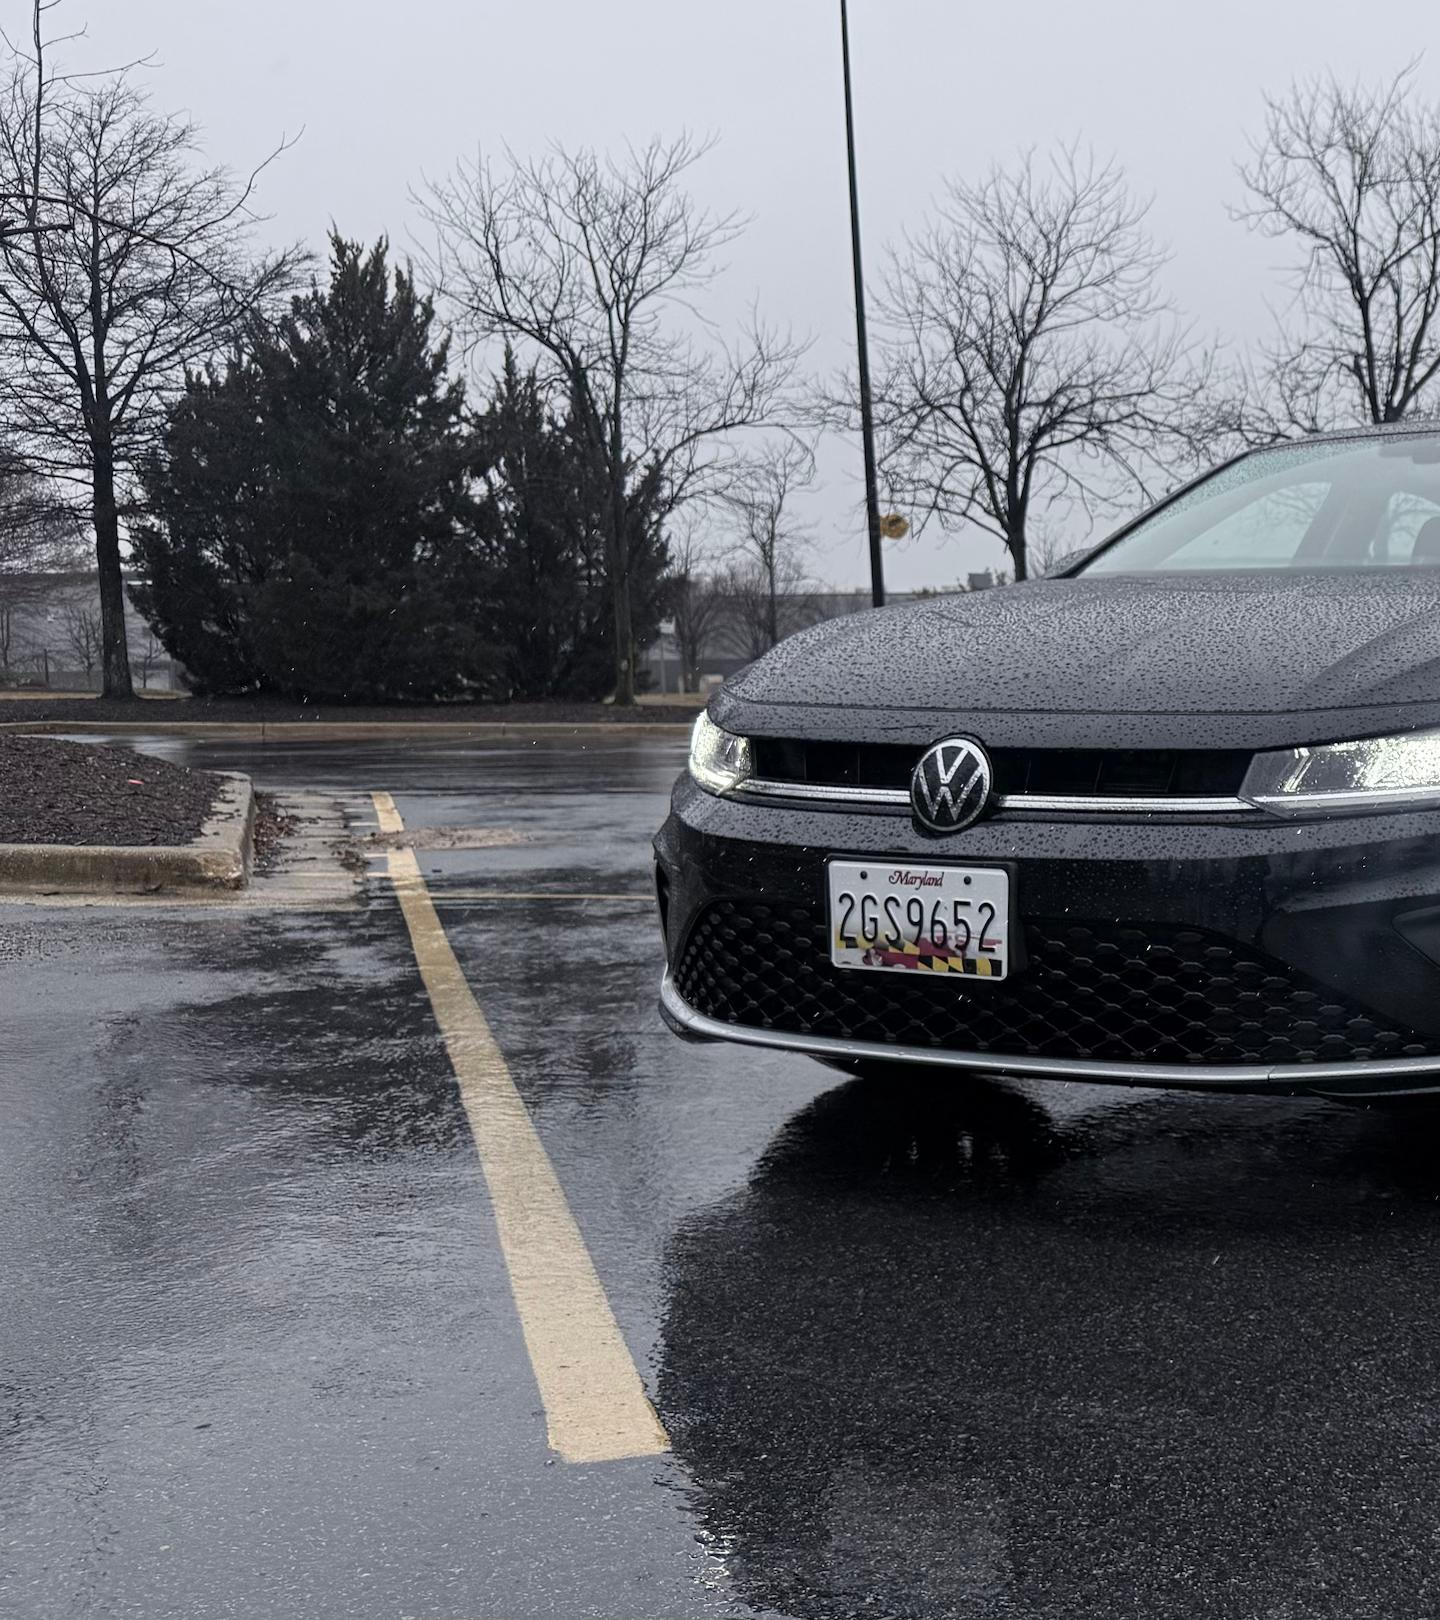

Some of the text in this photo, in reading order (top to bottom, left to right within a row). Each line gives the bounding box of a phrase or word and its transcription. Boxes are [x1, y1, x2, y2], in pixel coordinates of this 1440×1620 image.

[916, 744, 986, 824] VW
[888, 871, 945, 890] Maryland
[838, 892, 997, 953] 2GS9652
